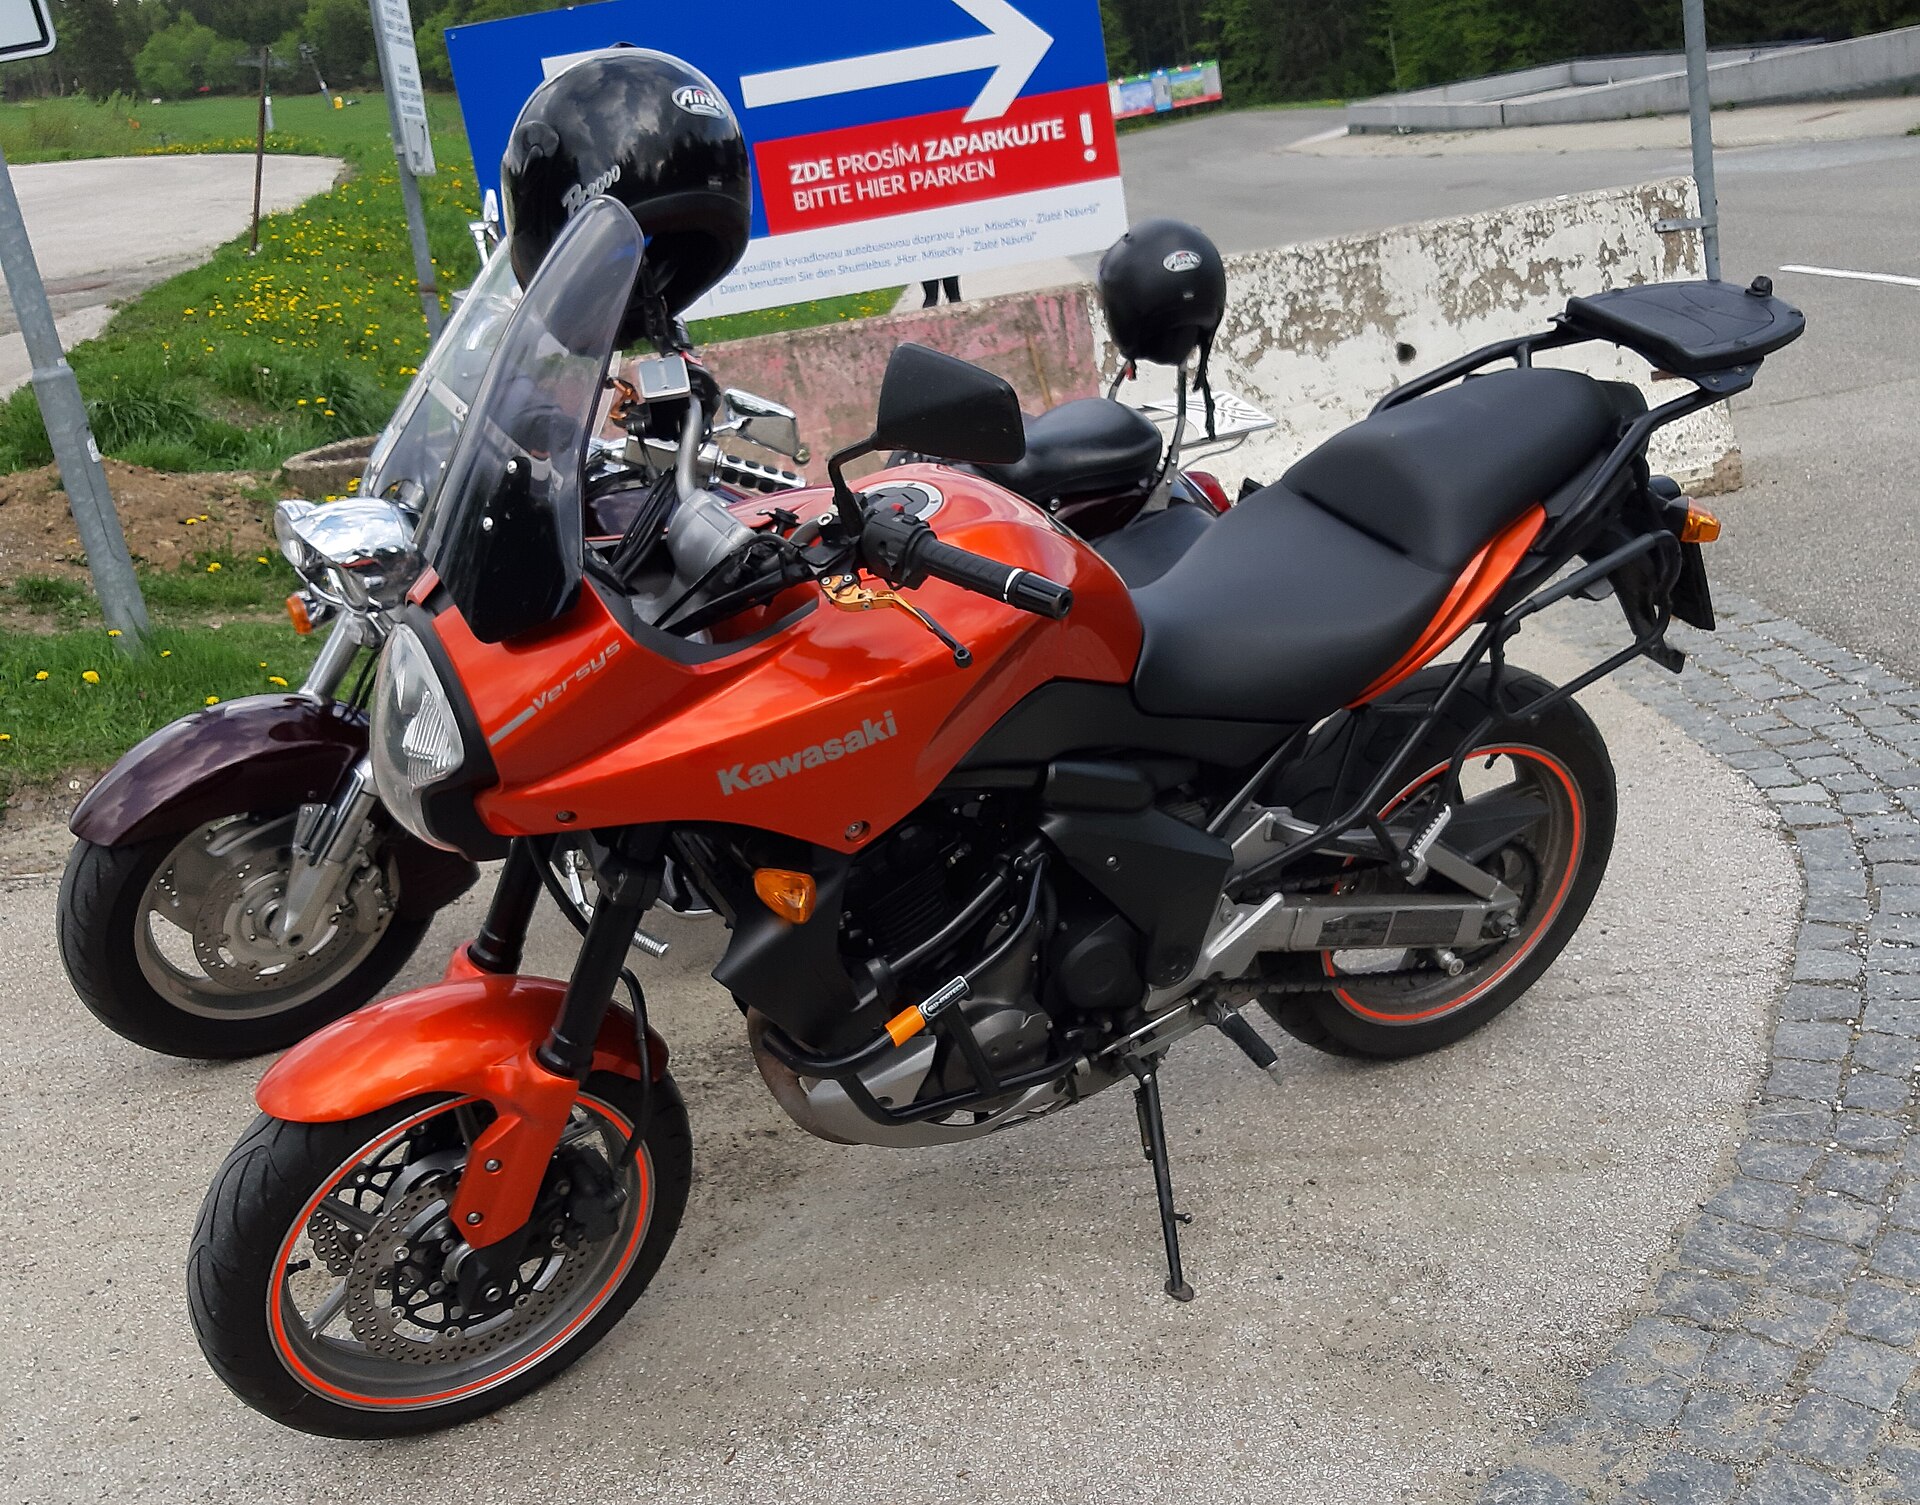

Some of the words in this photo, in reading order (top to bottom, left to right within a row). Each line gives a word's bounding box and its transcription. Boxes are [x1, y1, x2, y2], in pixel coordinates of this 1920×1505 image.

[789, 157, 834, 185] ZDE
[838, 142, 921, 176] PROSÍM
[923, 118, 1066, 163] ZAPARKUJTE
[1079, 112, 1098, 163] !
[793, 182, 853, 212] BITTE
[856, 171, 907, 201] HIER
[910, 158, 996, 192] PARKEN
[532, 639, 621, 710] Versys
[716, 709, 898, 796] Kawasaki
